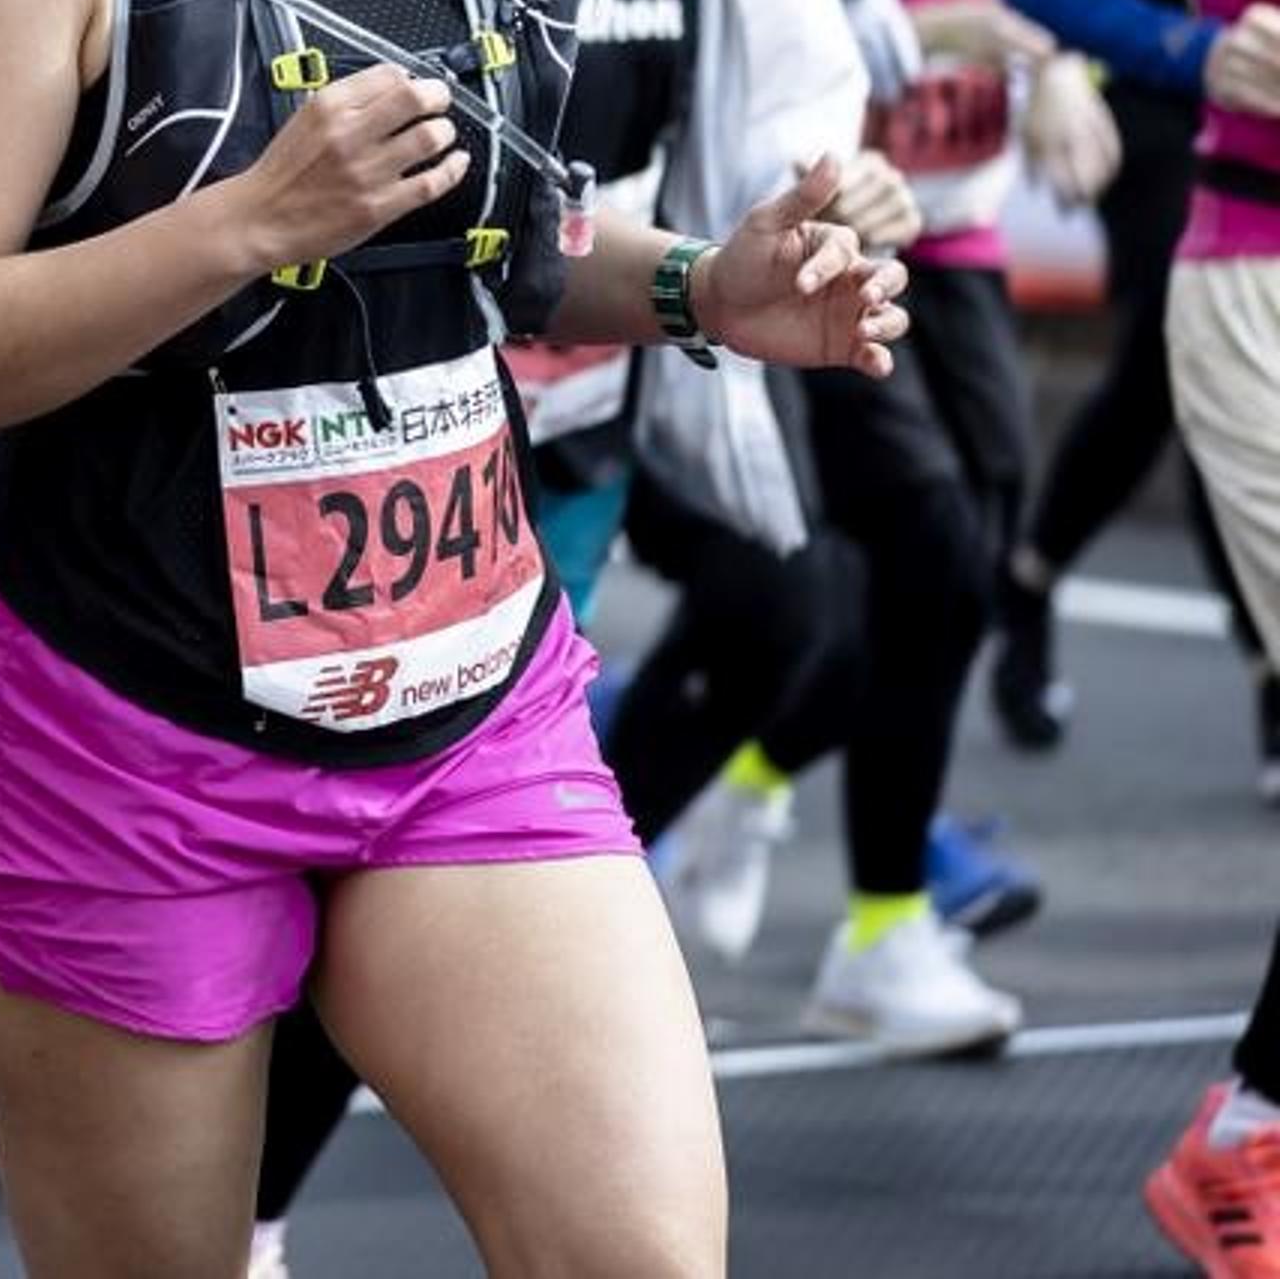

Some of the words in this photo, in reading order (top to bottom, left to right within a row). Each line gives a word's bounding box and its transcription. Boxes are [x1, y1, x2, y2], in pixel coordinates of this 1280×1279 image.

[228, 416, 307, 452] NGK
[320, 407, 394, 443] NT
[401, 676, 452, 708] new
